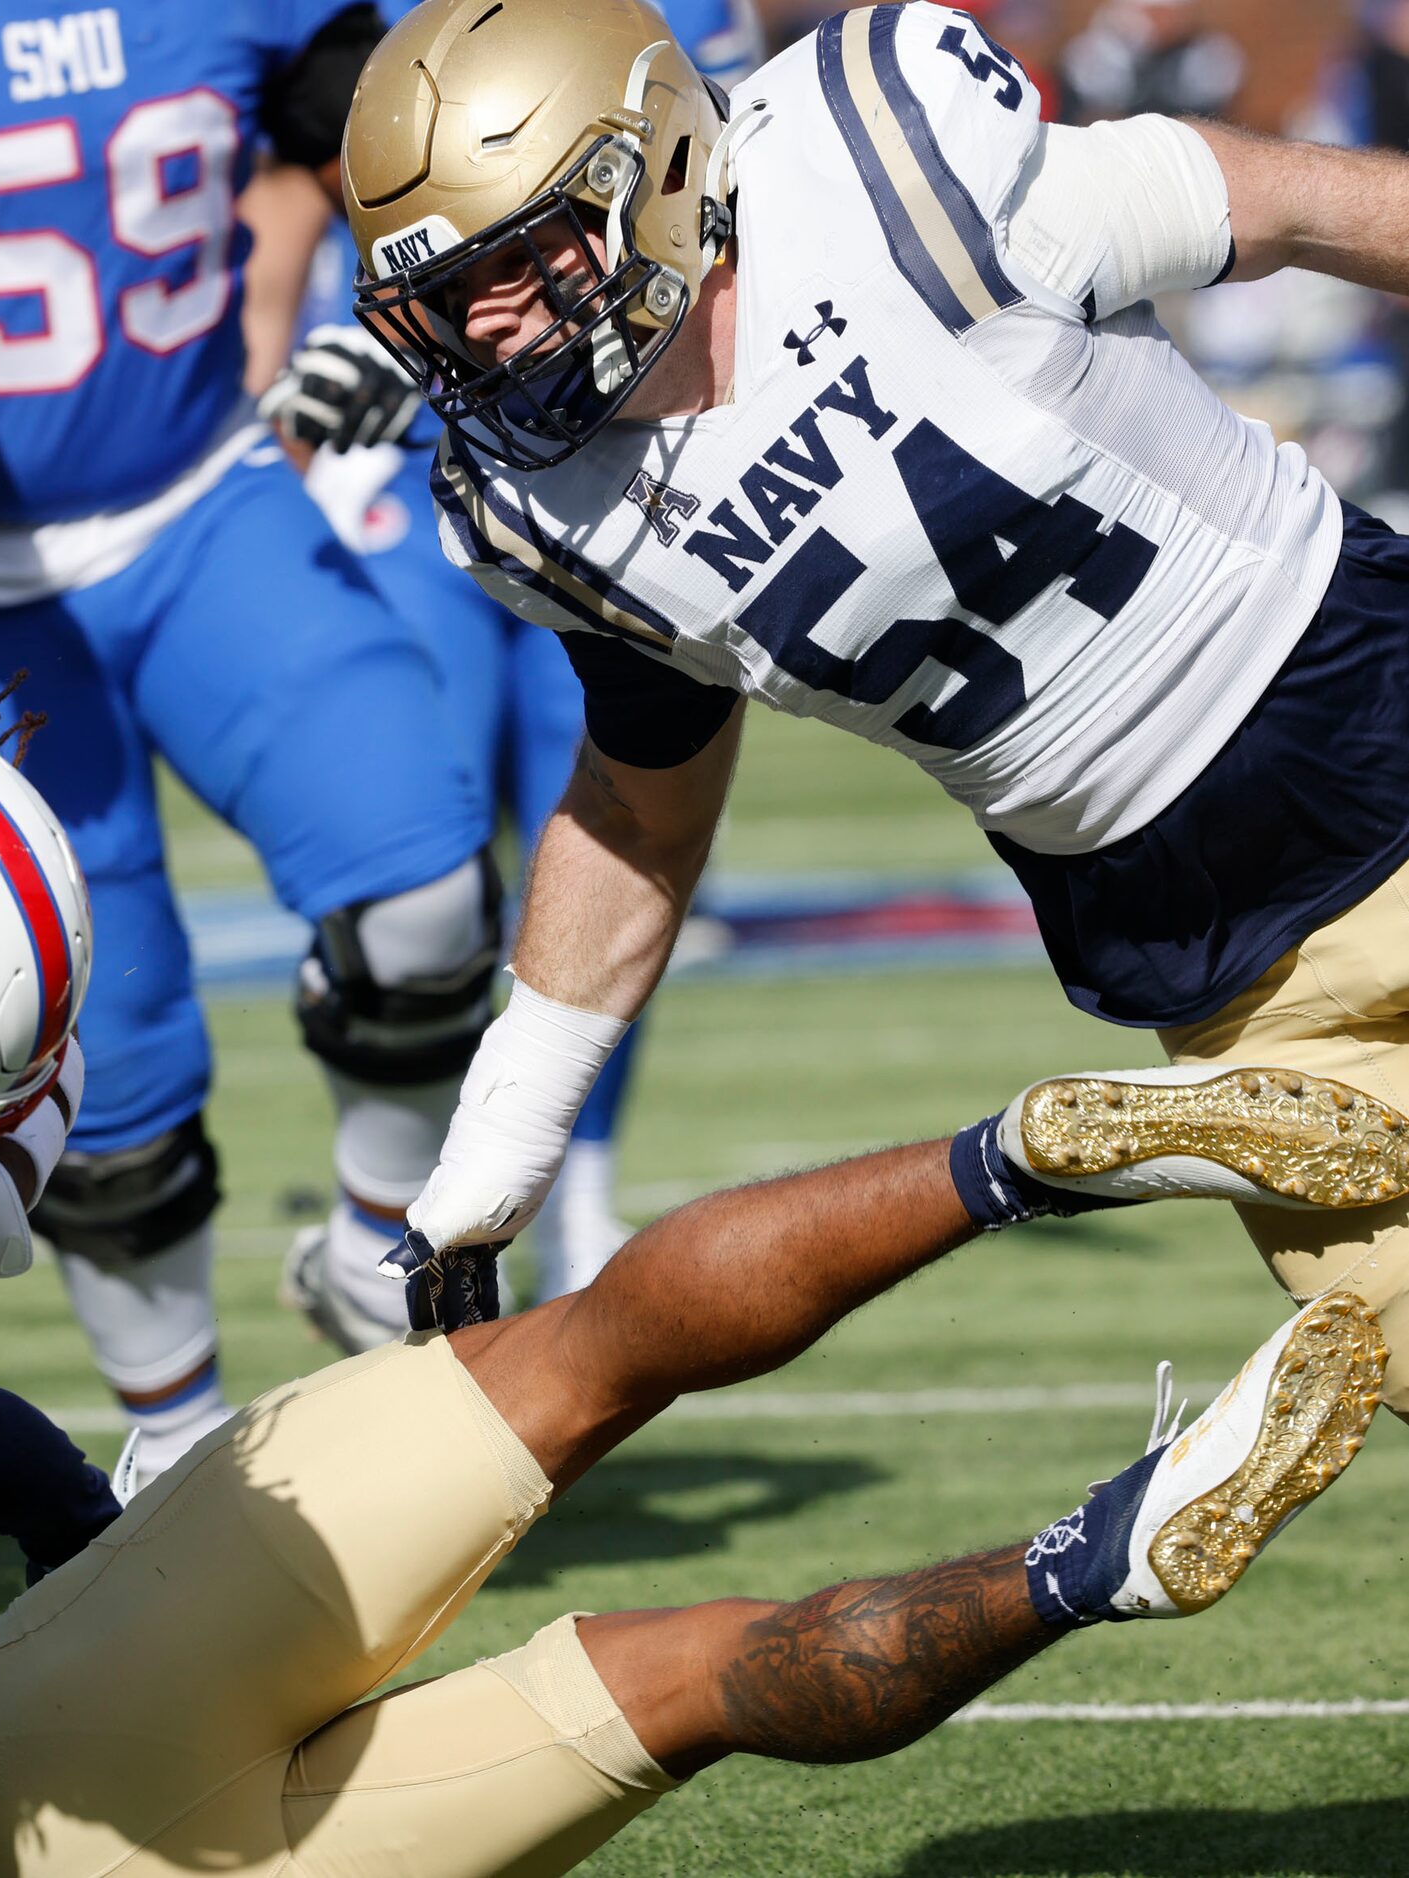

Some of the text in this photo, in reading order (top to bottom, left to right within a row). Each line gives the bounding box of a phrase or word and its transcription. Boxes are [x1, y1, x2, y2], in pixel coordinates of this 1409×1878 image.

[1, 7, 127, 103] SMU
[381, 228, 436, 273] NAVY
[683, 355, 898, 593] NAVY
[730, 417, 1159, 750] 54
